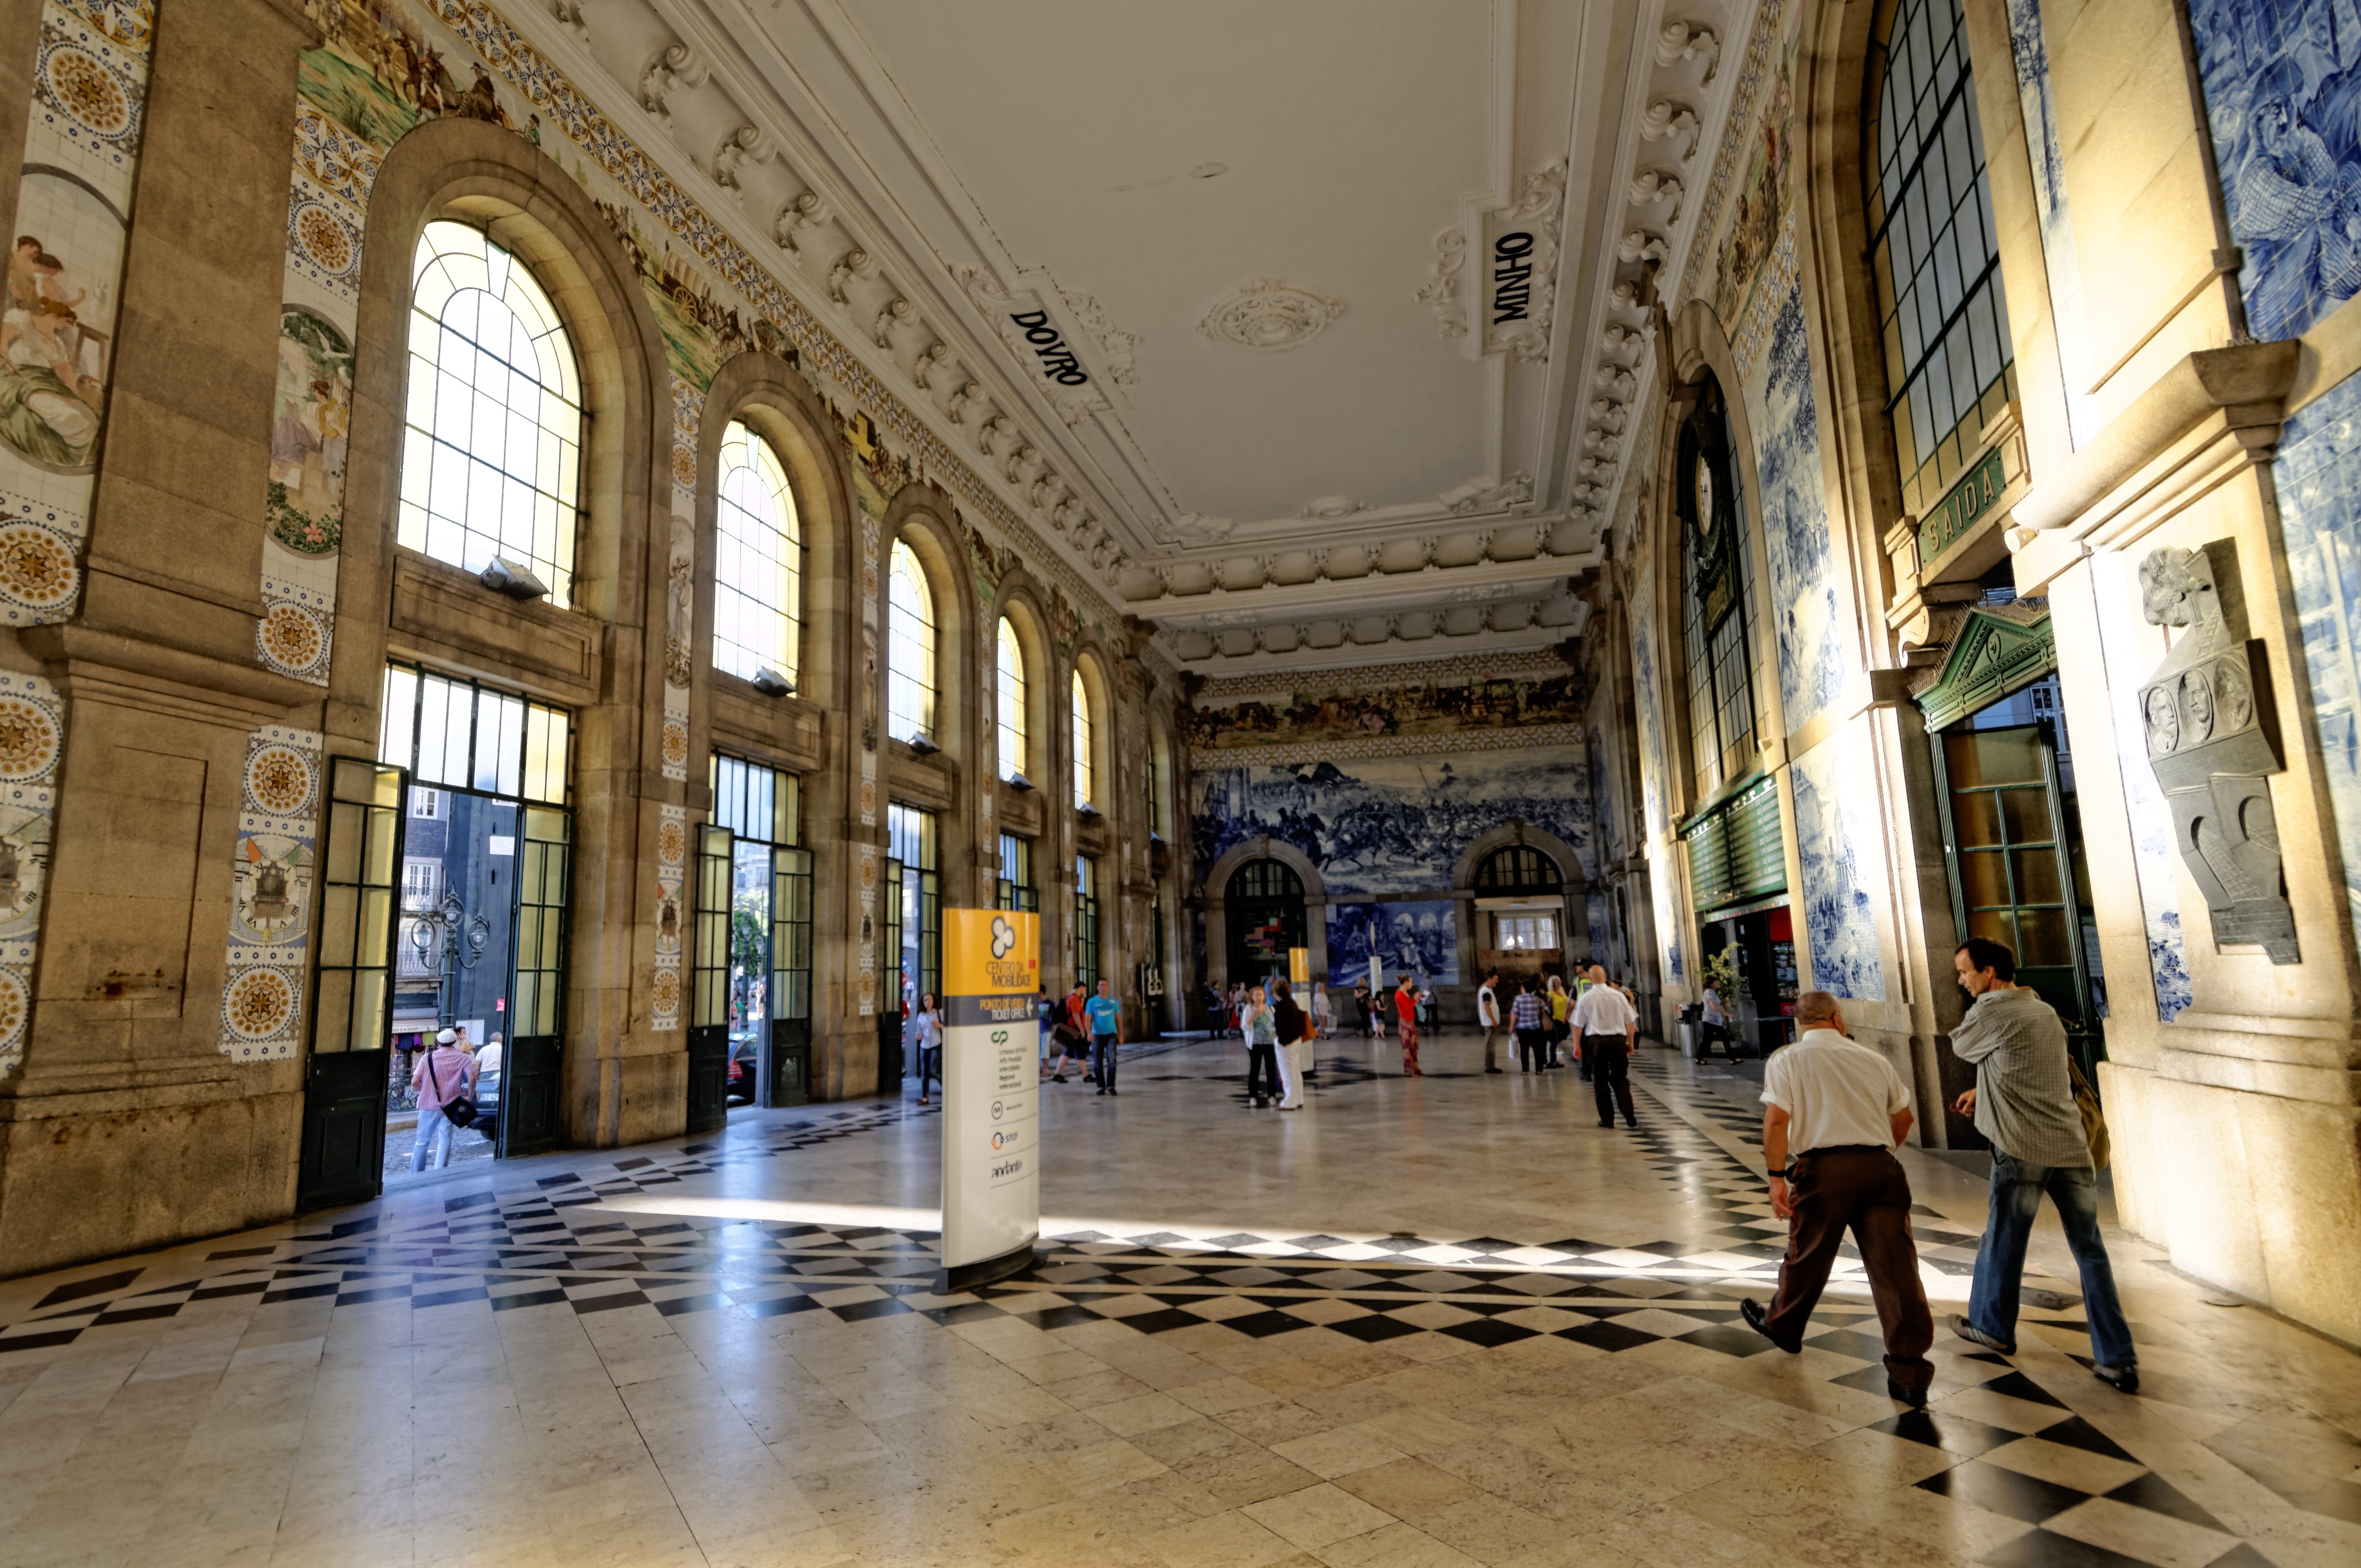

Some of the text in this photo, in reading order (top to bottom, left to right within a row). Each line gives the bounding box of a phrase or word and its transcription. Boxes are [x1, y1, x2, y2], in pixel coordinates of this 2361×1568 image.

[1494, 232, 1533, 325] MINHO
[1010, 310, 1087, 385] DOVRO
[1929, 467, 1995, 552] SAIDA
[986, 961, 1015, 976] CENTRO
[980, 998, 1002, 1011] PONTO
[991, 1008, 1025, 1021] TICKET OFFICE
